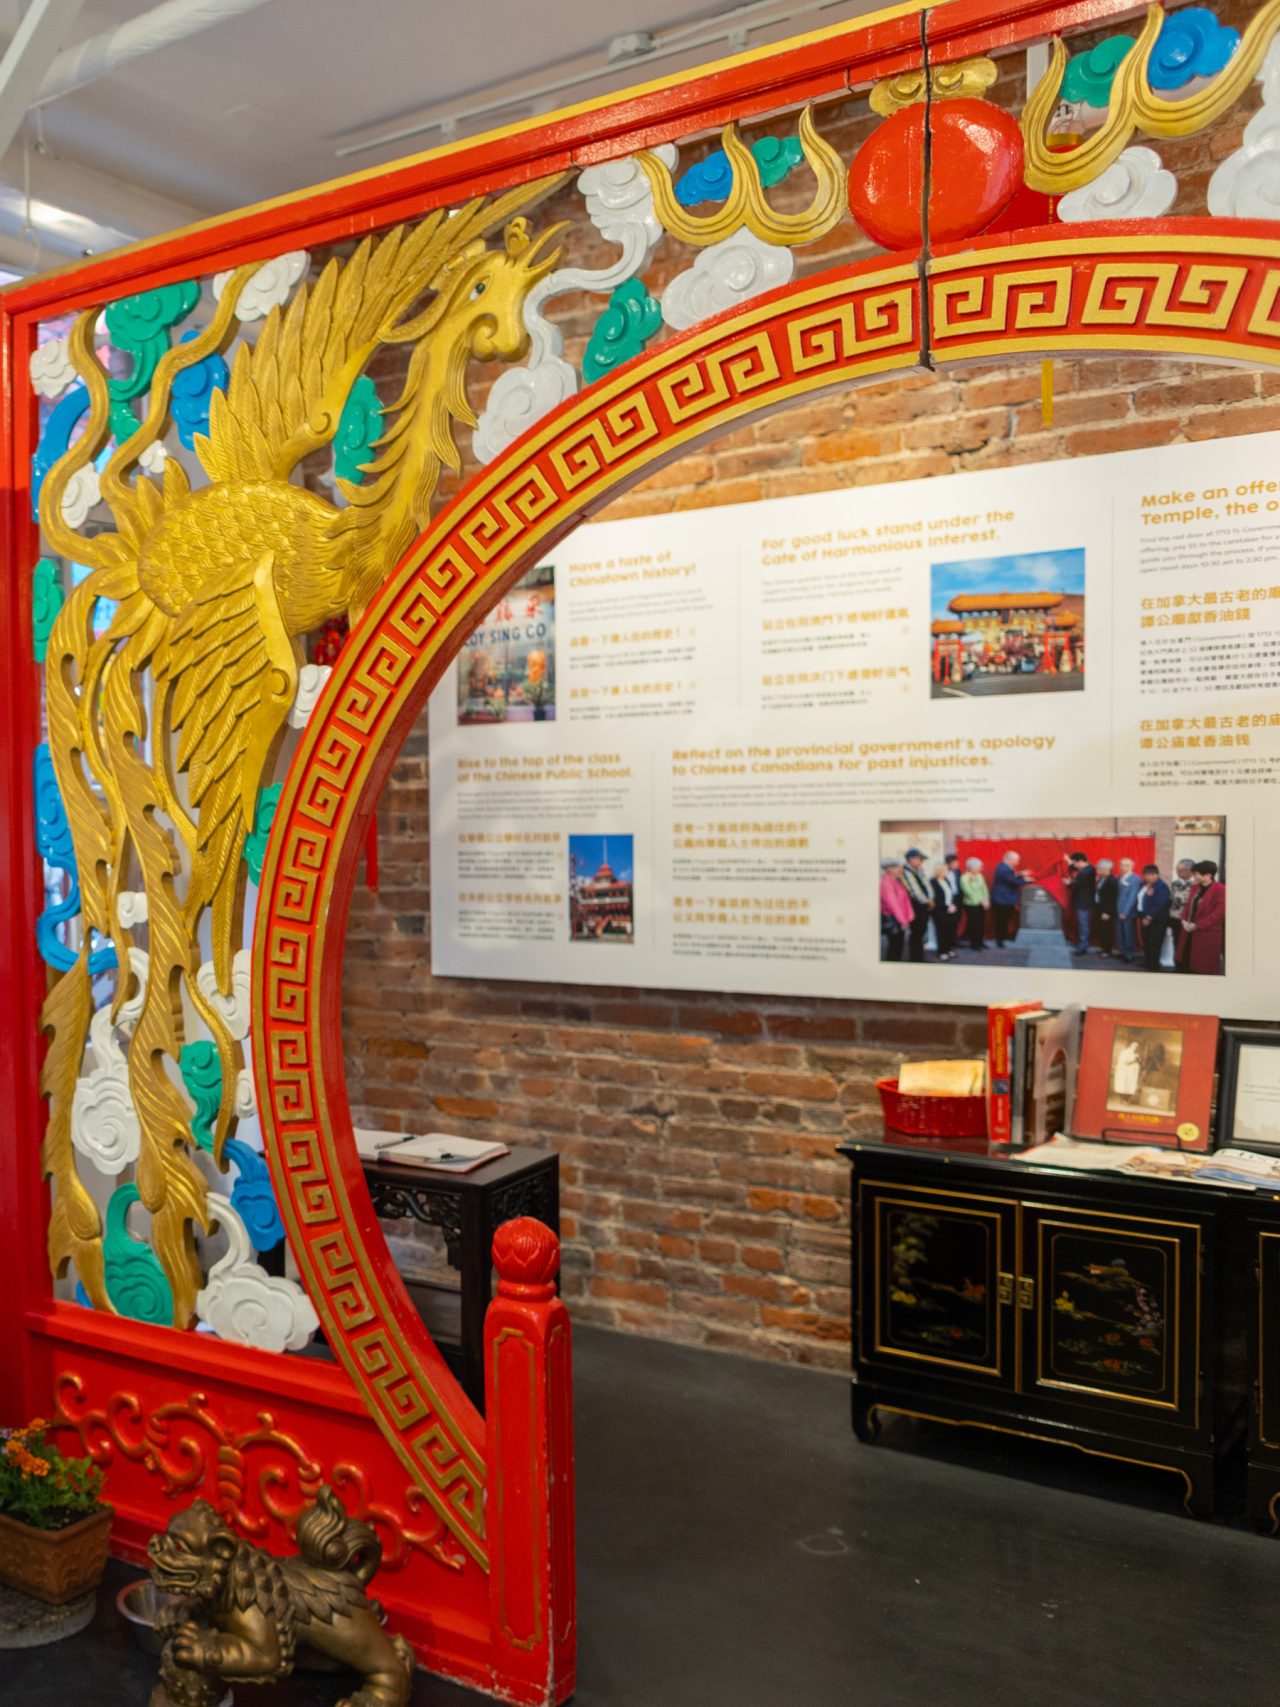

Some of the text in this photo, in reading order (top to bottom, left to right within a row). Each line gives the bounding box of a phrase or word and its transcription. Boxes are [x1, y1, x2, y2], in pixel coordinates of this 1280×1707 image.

[1141, 479, 1280, 508] Make an offe
[1141, 506, 1220, 525] Temple,
[1226, 501, 1259, 516] the
[762, 510, 1015, 549] For good luck stand under the
[1158, 534, 1170, 542] the
[762, 553, 797, 566] Gate
[801, 549, 817, 561] of
[823, 537, 923, 558] Harmonious
[1209, 539, 1222, 547] the
[569, 561, 602, 573] Have
[607, 559, 616, 569] a
[656, 551, 671, 563] of
[569, 572, 640, 588] Chinatown
[490, 626, 521, 643] SING
[526, 623, 547, 638] CO
[672, 735, 1057, 761] Reflect on the provincial government's apology
[457, 752, 622, 769] Rise to the top of the class
[672, 753, 994, 776] to Chinese Canadians for past injustices.
[473, 771, 492, 783] the
[495, 770, 542, 782] Chinese
[546, 768, 583, 780] Public
